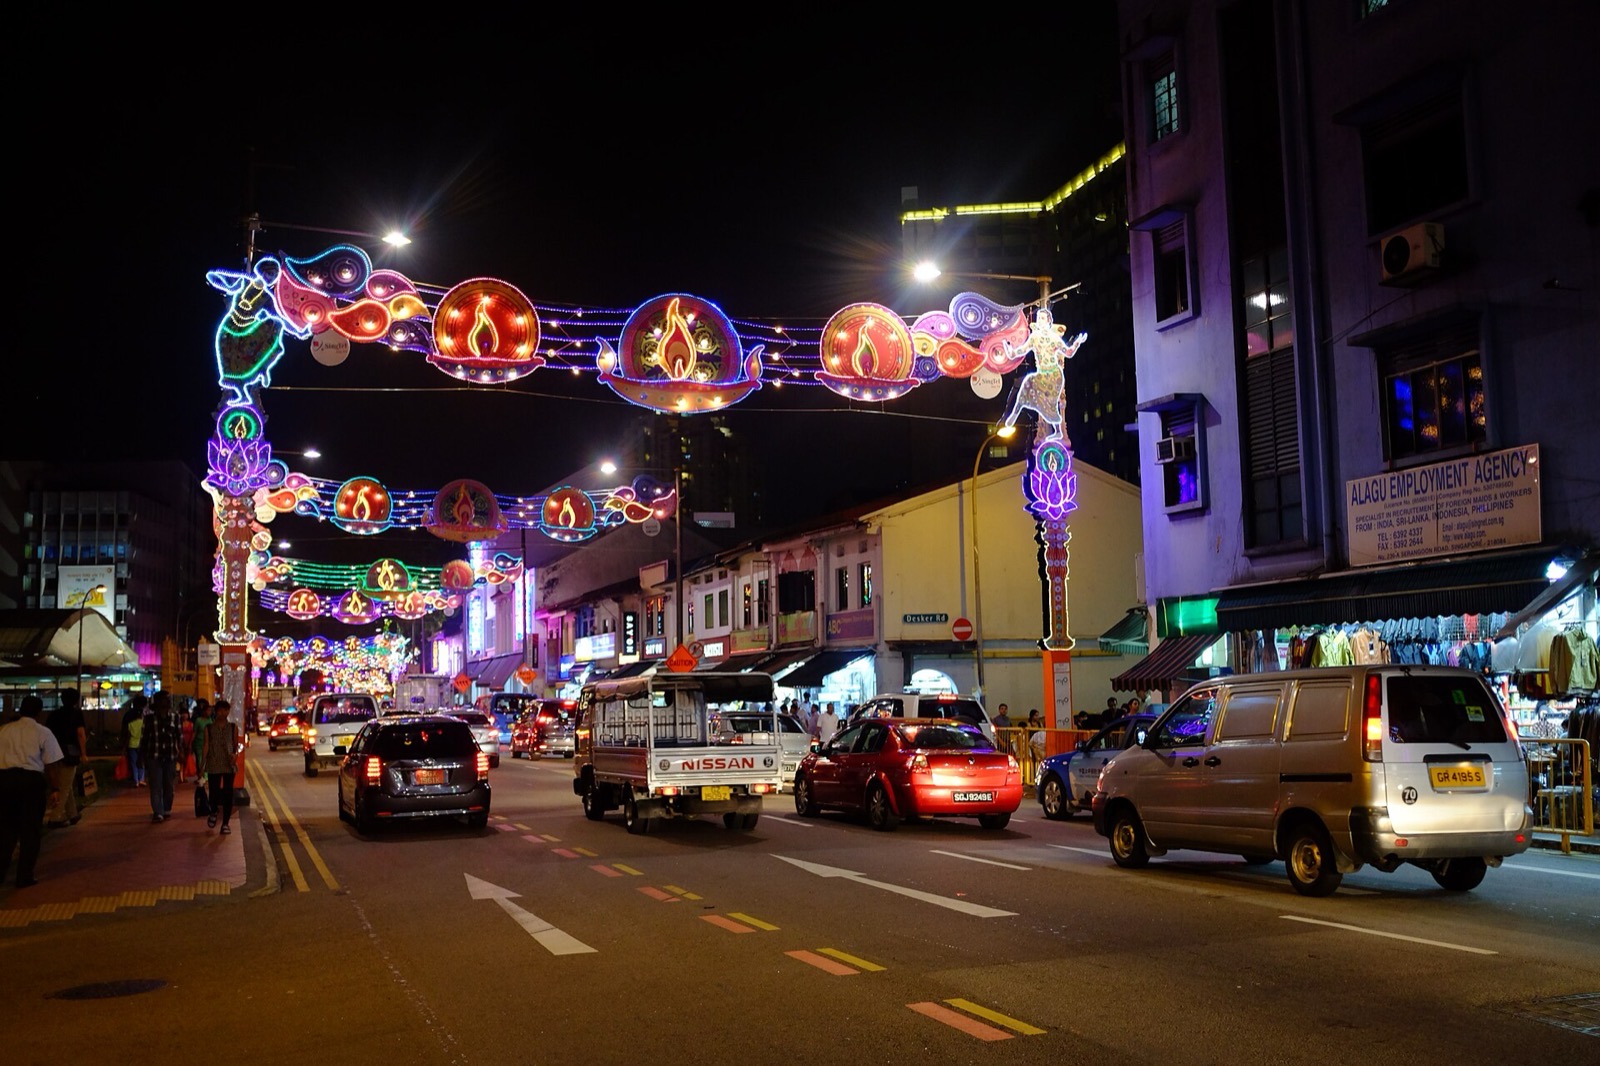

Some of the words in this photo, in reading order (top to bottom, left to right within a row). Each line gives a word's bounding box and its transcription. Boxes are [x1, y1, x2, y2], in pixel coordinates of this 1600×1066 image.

[1351, 478, 1387, 506] ALAGU
[1390, 461, 1469, 499] EMPLOYMENT
[1475, 450, 1528, 484] AGENCY
[1356, 512, 1384, 523] SPECIALIST
[1437, 502, 1444, 510] OF
[1446, 497, 1471, 508] FOREIGN
[1473, 494, 1492, 504] MAIDS
[1500, 487, 1532, 499] WORKERS
[1356, 524, 1372, 533] FROM
[1472, 499, 1514, 514] PHILLIPINES
[1378, 533, 1388, 542] TEL
[1393, 530, 1407, 540] 6392
[1409, 527, 1423, 537] 4337
[1378, 542, 1389, 551] FAX
[1393, 539, 1407, 549] 6392
[1409, 537, 1424, 546] 2644
[906, 614, 933, 623] Desker
[936, 614, 946, 622] Rd
[827, 619, 842, 634] ABC
[669, 659, 693, 667] CAUTION
[682, 757, 754, 771] NISSAN
[1437, 771, 1450, 783] GR
[1452, 771, 1473, 782] 4195
[1475, 771, 1481, 782] S
[1404, 789, 1416, 799] 70
